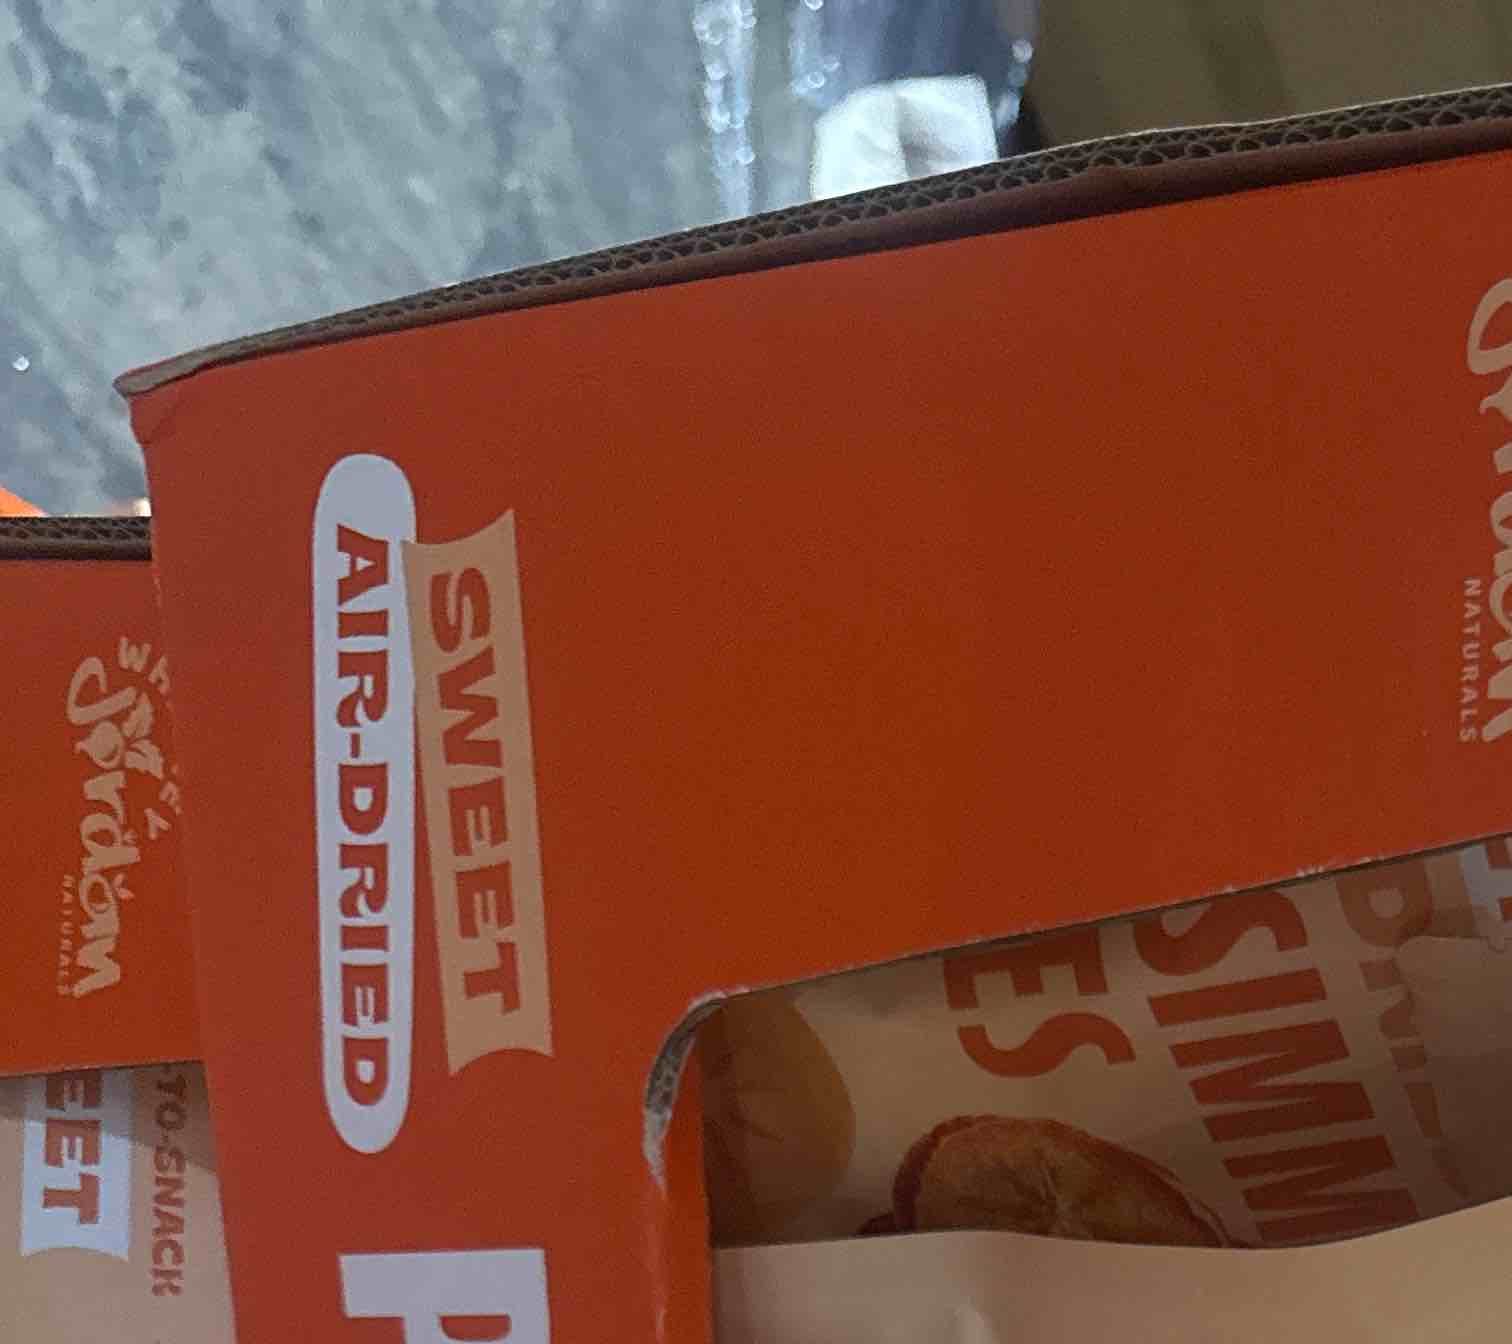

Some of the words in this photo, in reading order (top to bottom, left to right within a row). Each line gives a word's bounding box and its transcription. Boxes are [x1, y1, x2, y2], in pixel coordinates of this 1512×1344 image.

[65, 656, 142, 998] Jordan
[334, 523, 392, 1108] AIR-DRIED
[428, 566, 522, 1016] SWEET
[1458, 577, 1483, 743] NATURALS
[41, 1069, 104, 1226] EET
